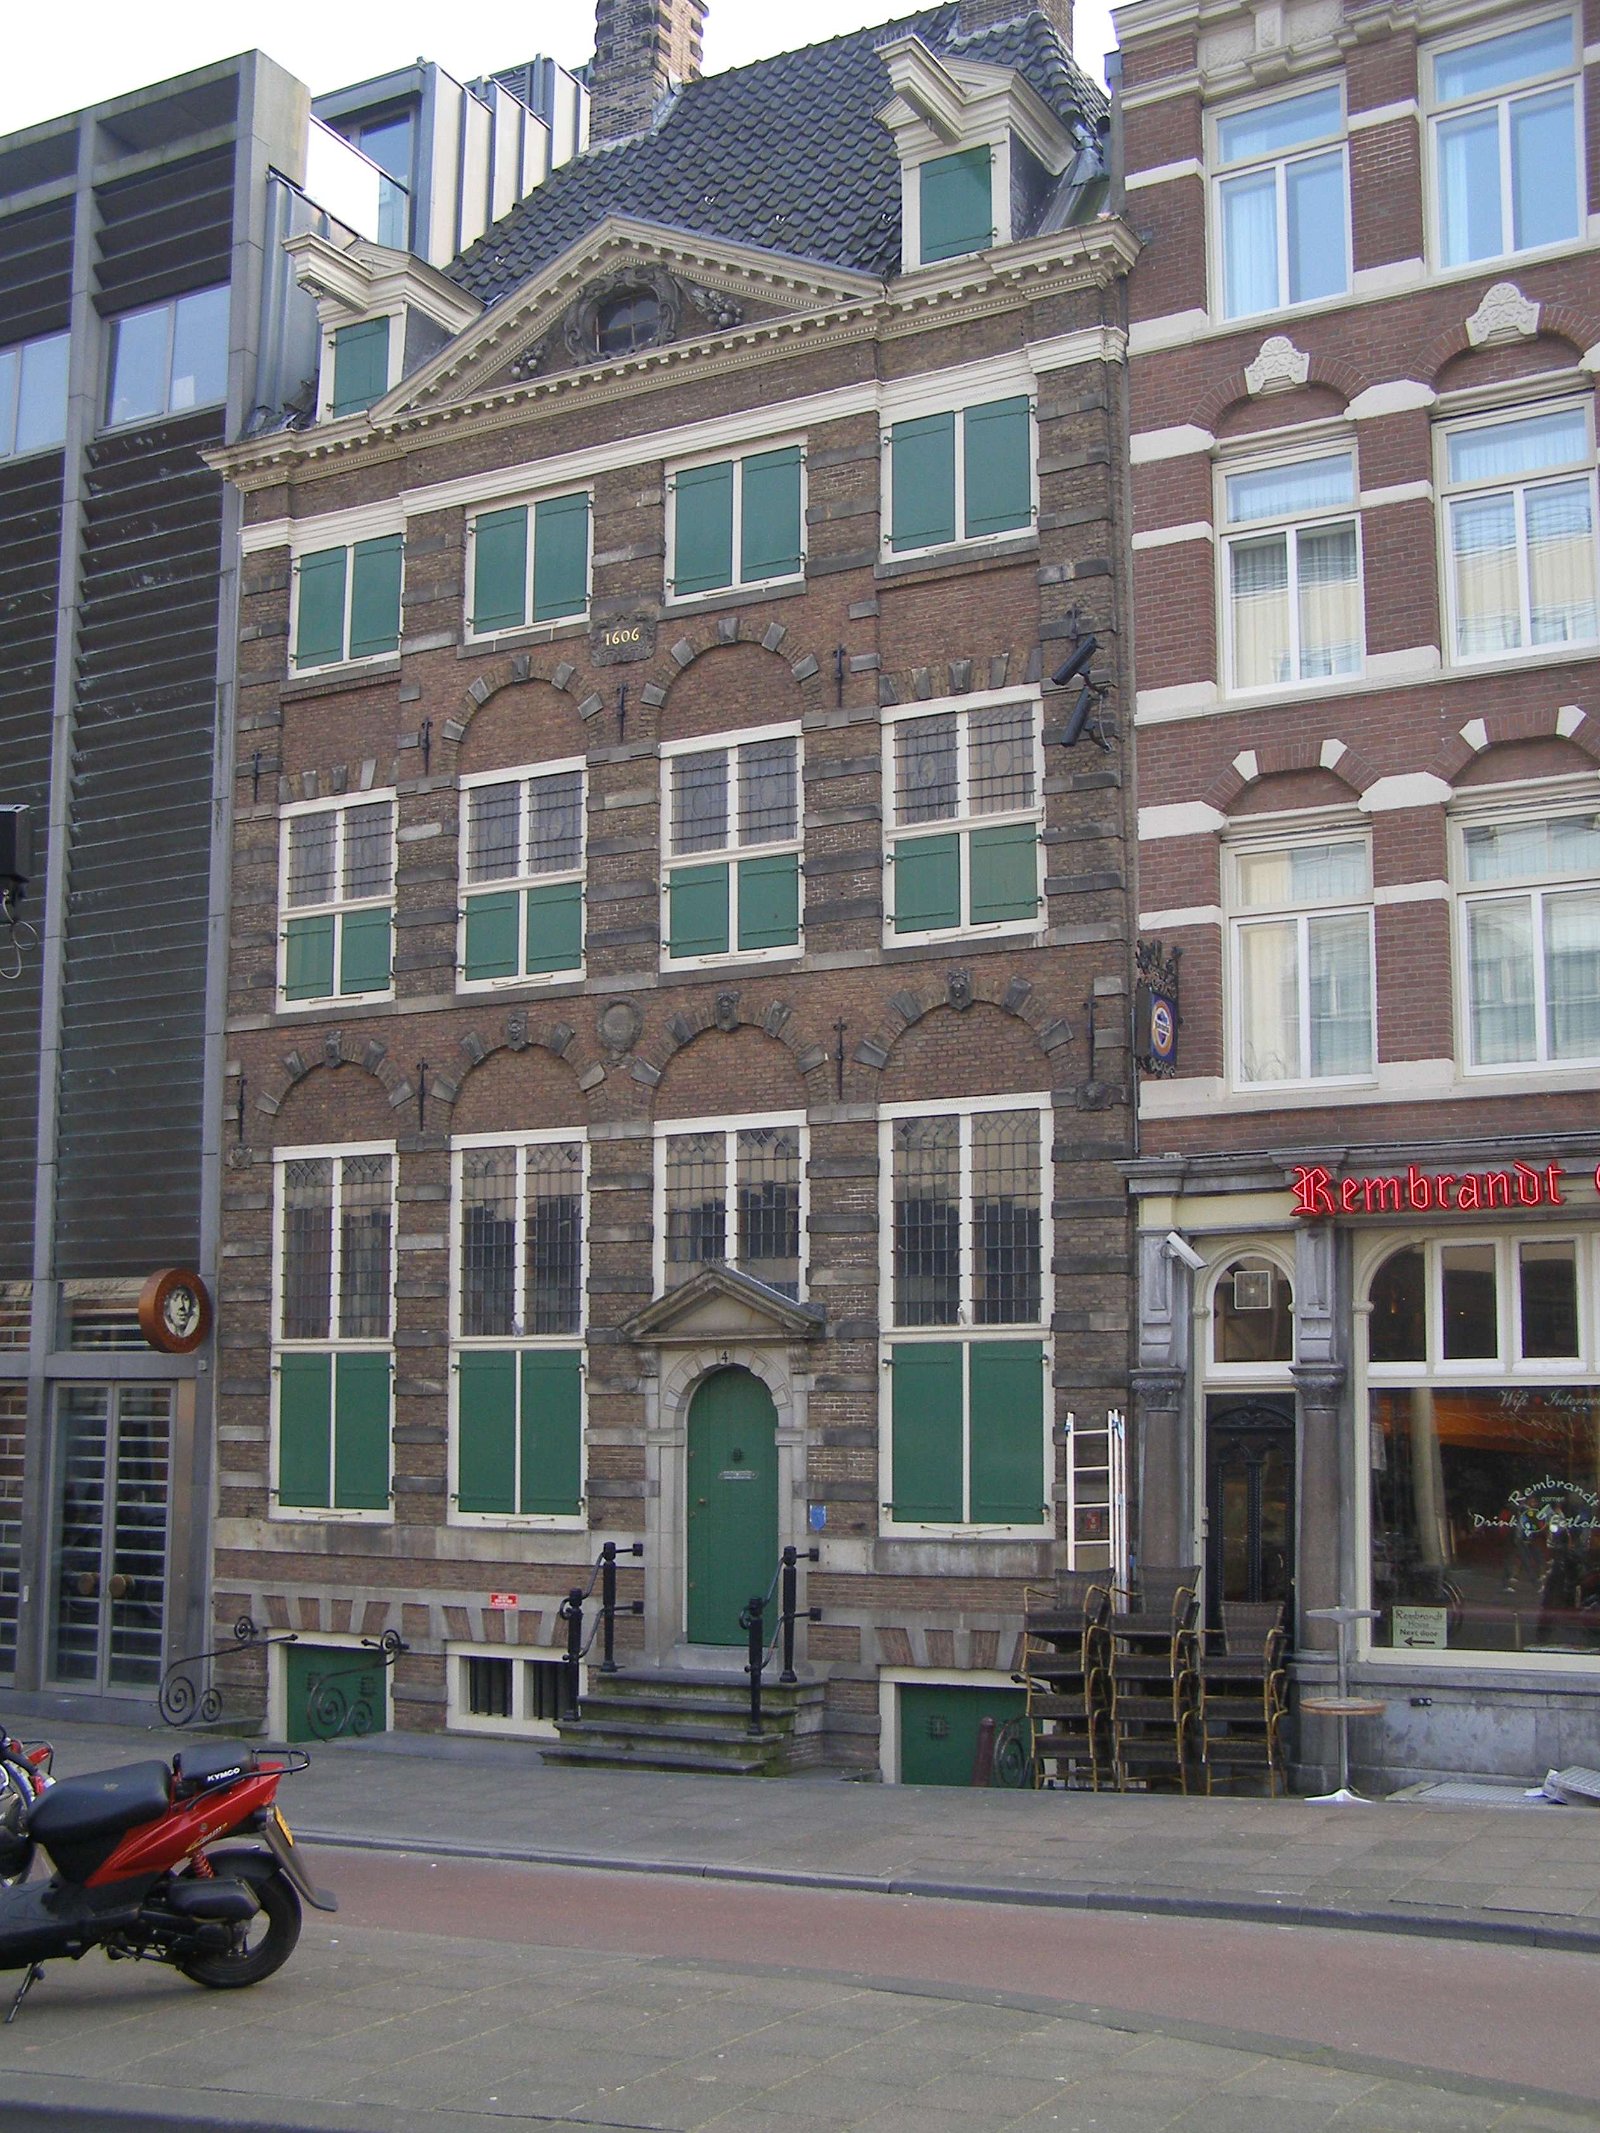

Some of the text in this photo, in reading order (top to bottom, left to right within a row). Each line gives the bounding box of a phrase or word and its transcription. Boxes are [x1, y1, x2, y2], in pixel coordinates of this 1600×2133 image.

[605, 627, 639, 646] 1606
[1289, 1159, 1565, 1217] Rembrandt
[721, 1350, 728, 1363] 4
[1508, 1474, 1600, 1507] Rembrandt
[1473, 1512, 1518, 1529] Drink
[1395, 1609, 1442, 1620] Rembrandt
[1400, 1629, 1419, 1637] Next
[207, 1767, 241, 1782] KYMCO
